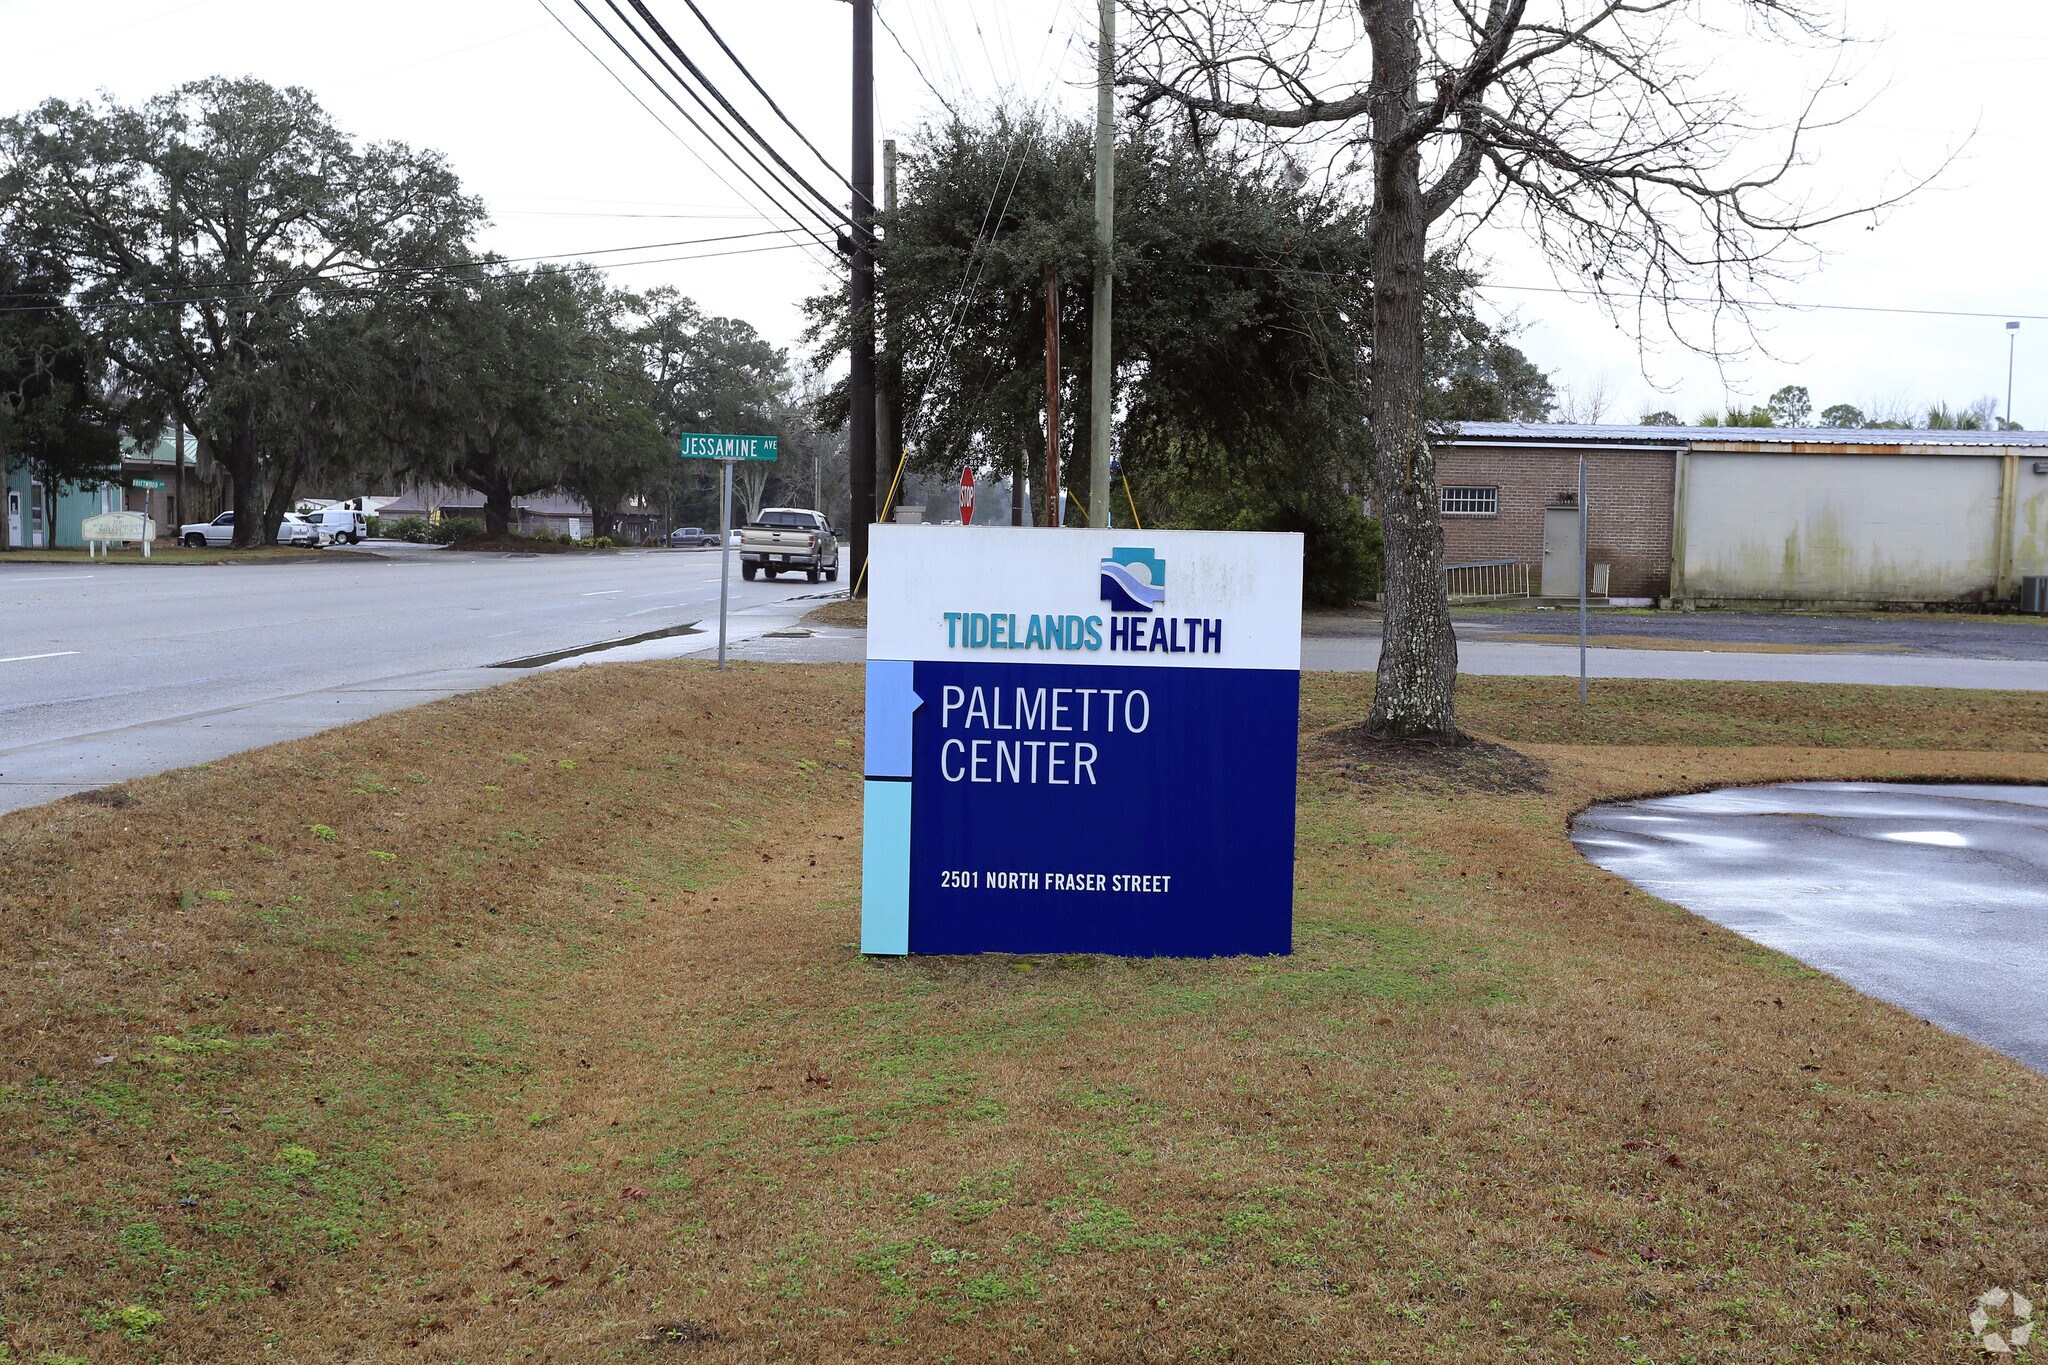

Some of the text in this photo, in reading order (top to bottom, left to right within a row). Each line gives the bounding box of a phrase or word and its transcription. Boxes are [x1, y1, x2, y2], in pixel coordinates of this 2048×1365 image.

[682, 437, 778, 457] JESSAMINE AVE
[132, 479, 159, 489] DRIFTWOOD
[960, 485, 974, 508] STOP
[944, 612, 1222, 653] TIDELANDS HEALTH
[942, 685, 1150, 734] PALMETTO
[941, 738, 1098, 785] CENTER
[941, 870, 1171, 893] 2501 NORTH FRASER STREET
